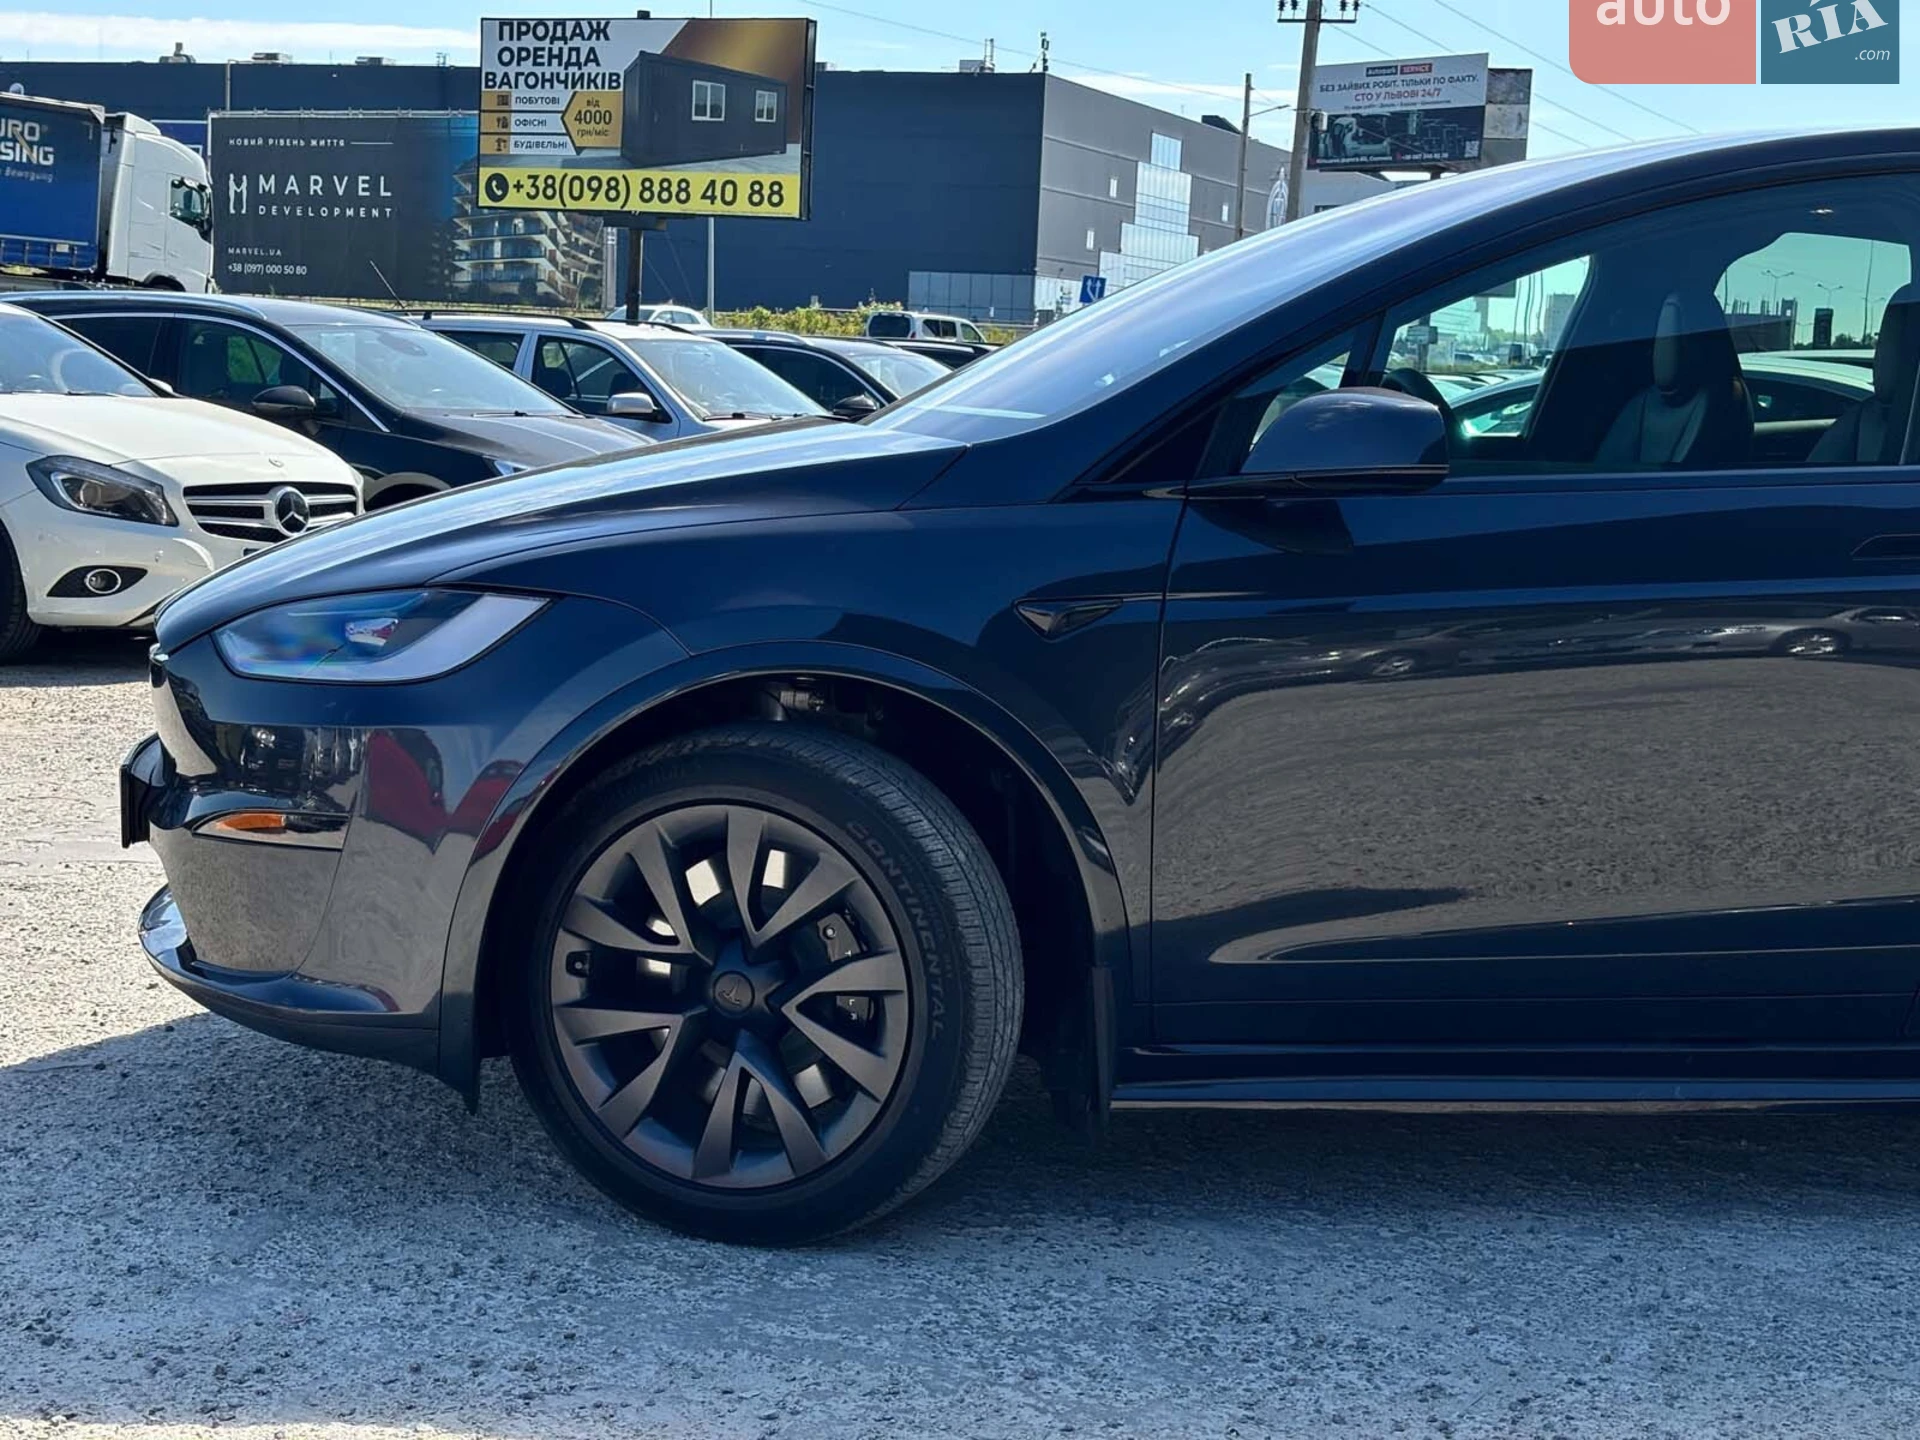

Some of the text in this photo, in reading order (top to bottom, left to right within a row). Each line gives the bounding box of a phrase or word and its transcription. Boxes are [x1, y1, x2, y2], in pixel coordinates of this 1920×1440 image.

[498, 21, 610, 44] ПРОДАЖ
[497, 47, 601, 70] ОРЕНДА
[484, 71, 622, 91] ВАГОНЧИКІВ
[1320, 84, 1335, 92] БЕЗ
[1401, 78, 1431, 88] ТІЛЬКИ
[1433, 76, 1445, 85] ПО
[515, 96, 560, 106] ПОБУТОВІ
[1354, 91, 1373, 102] СТО
[1375, 91, 1382, 101] У
[1384, 89, 1419, 100] ЛЬВОВІ
[586, 98, 600, 108] від
[514, 117, 547, 128] ОФІСНІ
[574, 109, 612, 126] 4000
[229, 137, 346, 147] НОВИЙ РІВЕНЬ ЖИТТЯ
[513, 140, 568, 151] БУДІВЕЛЬНІ
[258, 174, 393, 197] MARVEL
[512, 174, 784, 209] +38(098) 888 40 88
[258, 205, 393, 218] DEVELOPMENT
[228, 247, 282, 256] MARVEL.UA
[265, 264, 282, 275] 000
[846, 821, 944, 1040] CONTINENTAL
